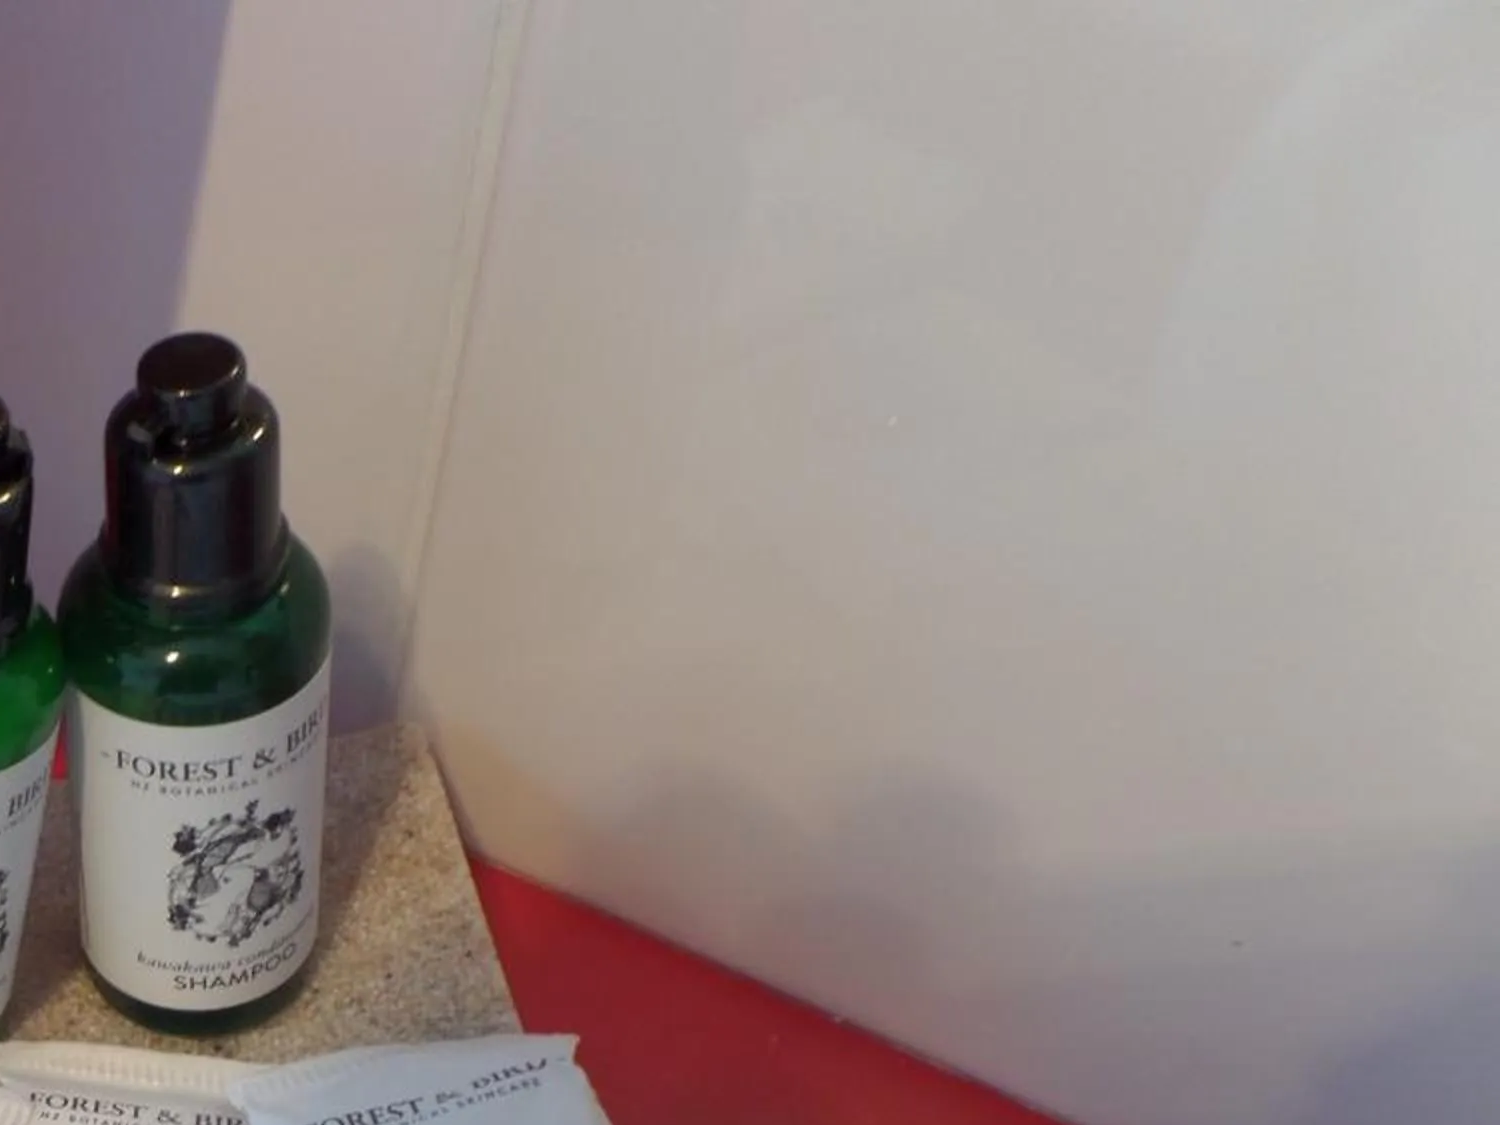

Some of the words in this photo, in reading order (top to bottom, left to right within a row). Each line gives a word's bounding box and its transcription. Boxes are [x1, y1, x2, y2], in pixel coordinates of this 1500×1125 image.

[115, 749, 244, 783] FOREST
[253, 746, 276, 770] &
[286, 703, 324, 753] BIR
[8, 767, 47, 818] BIR
[172, 942, 298, 991] SHAMPOO
[29, 1090, 150, 1120] FOREST
[456, 1076, 542, 1109] SKINCARE
